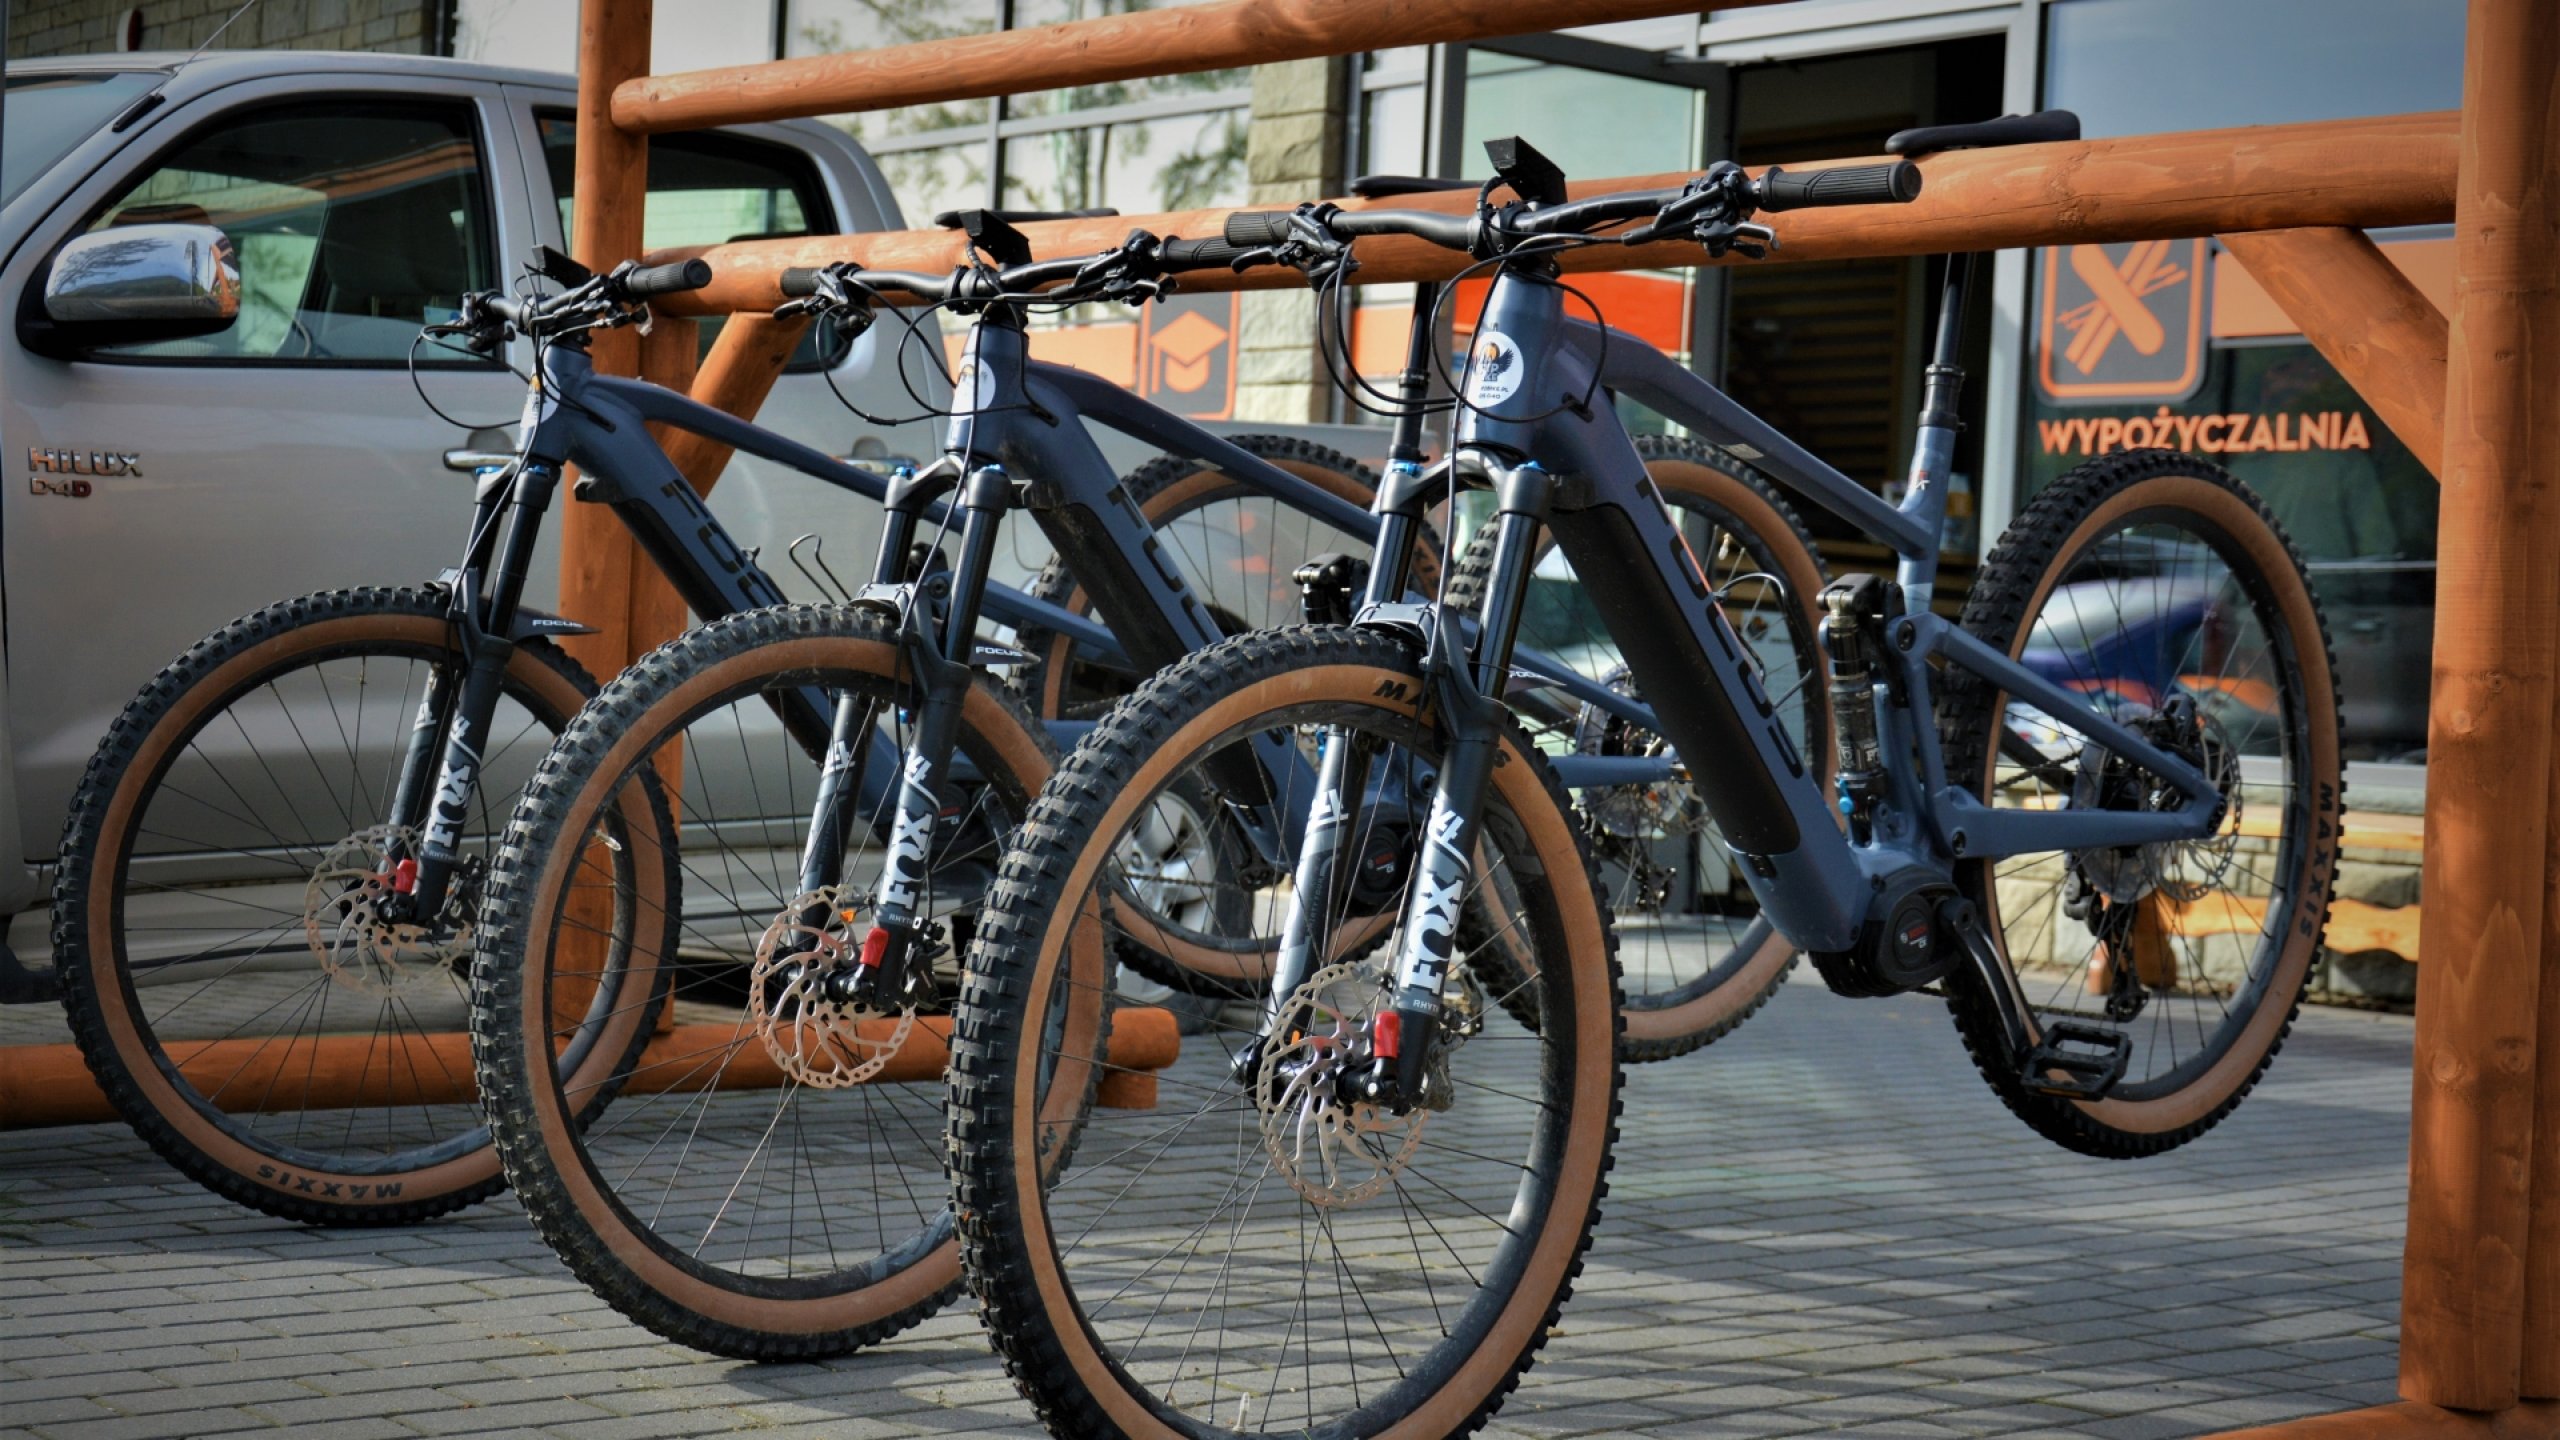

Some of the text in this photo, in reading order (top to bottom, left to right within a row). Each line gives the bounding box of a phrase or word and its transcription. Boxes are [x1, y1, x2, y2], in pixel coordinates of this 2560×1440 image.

[28, 447, 143, 477] HILUX
[2038, 405, 2371, 456] WYPOŻYCZALNIA
[975, 646, 1023, 657] FOCUS
[424, 762, 471, 848] FOX
[879, 807, 934, 911] FOX
[2300, 781, 2334, 938] MAXXIS
[1400, 869, 1464, 996] FOX
[256, 1163, 403, 1199] MAXXIS
